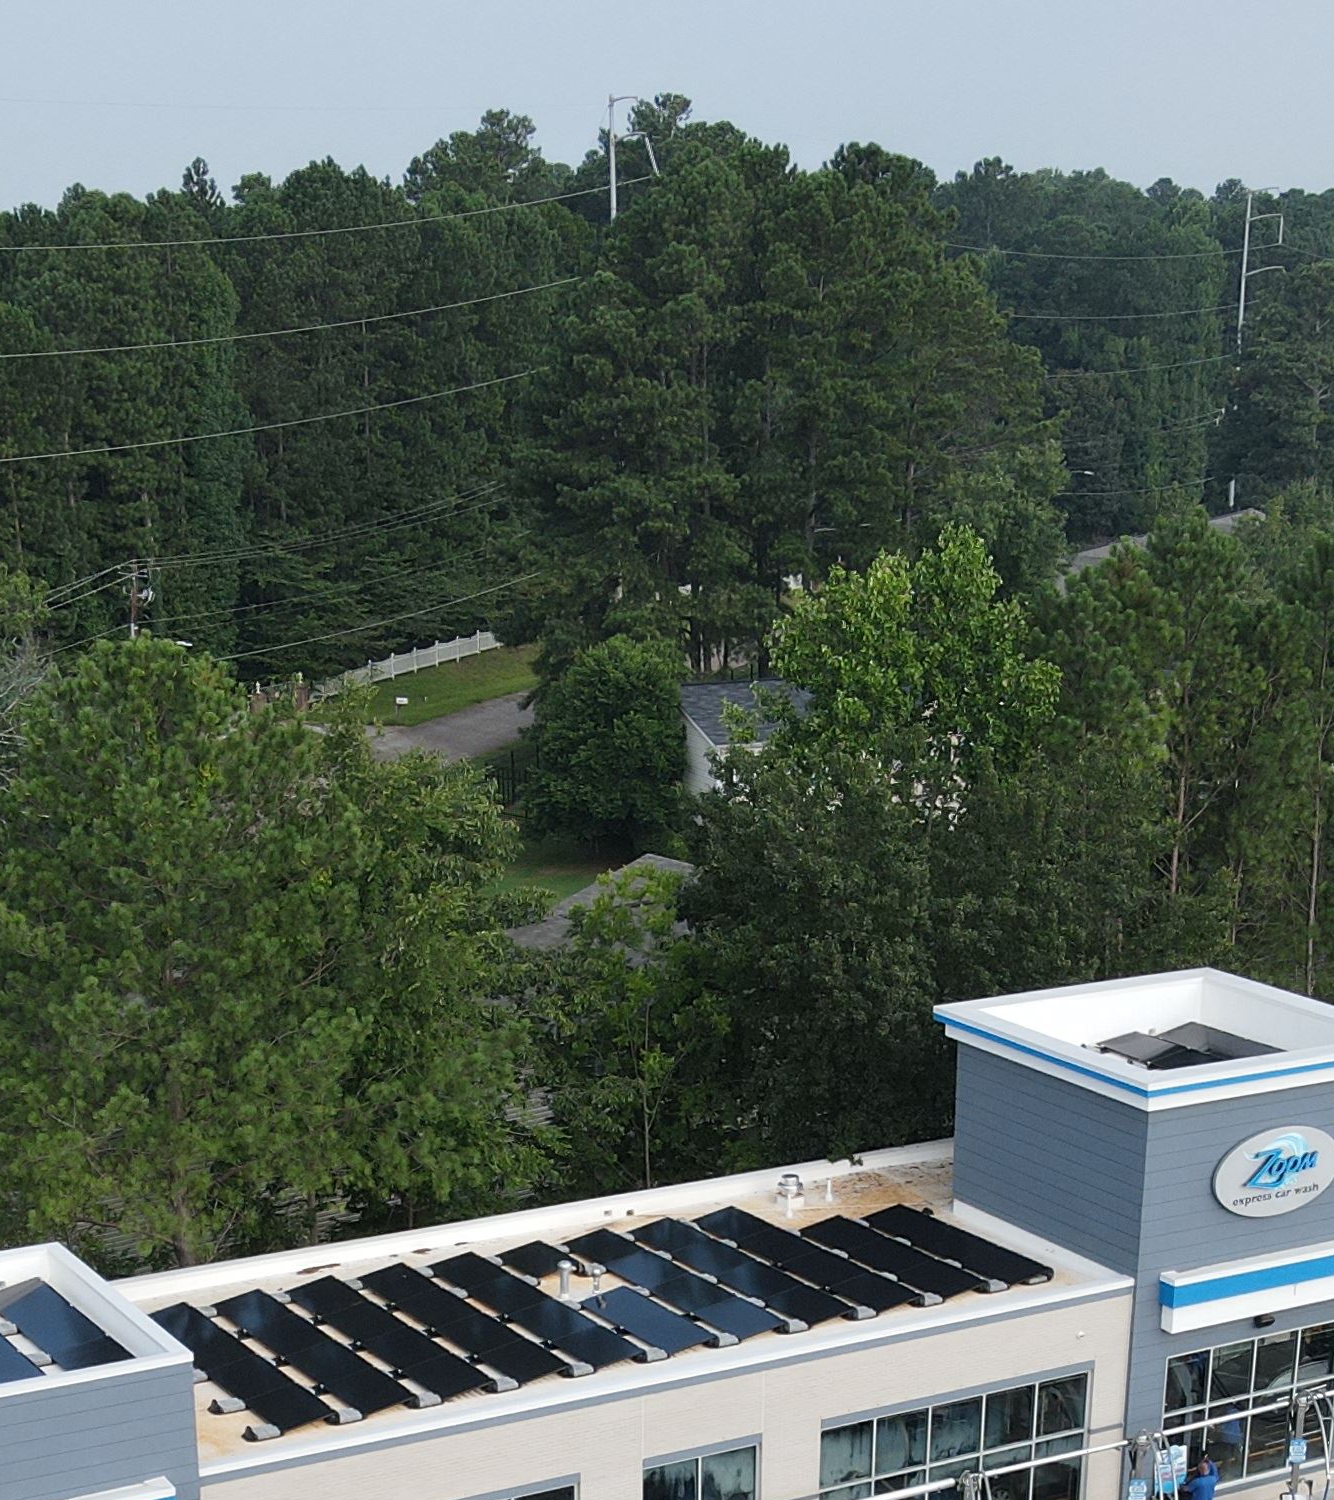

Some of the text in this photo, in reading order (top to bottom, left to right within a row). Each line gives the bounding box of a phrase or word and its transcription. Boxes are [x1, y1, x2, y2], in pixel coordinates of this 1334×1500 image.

[1242, 1147, 1319, 1190] Zoom
[1232, 1182, 1319, 1207] express car wash
